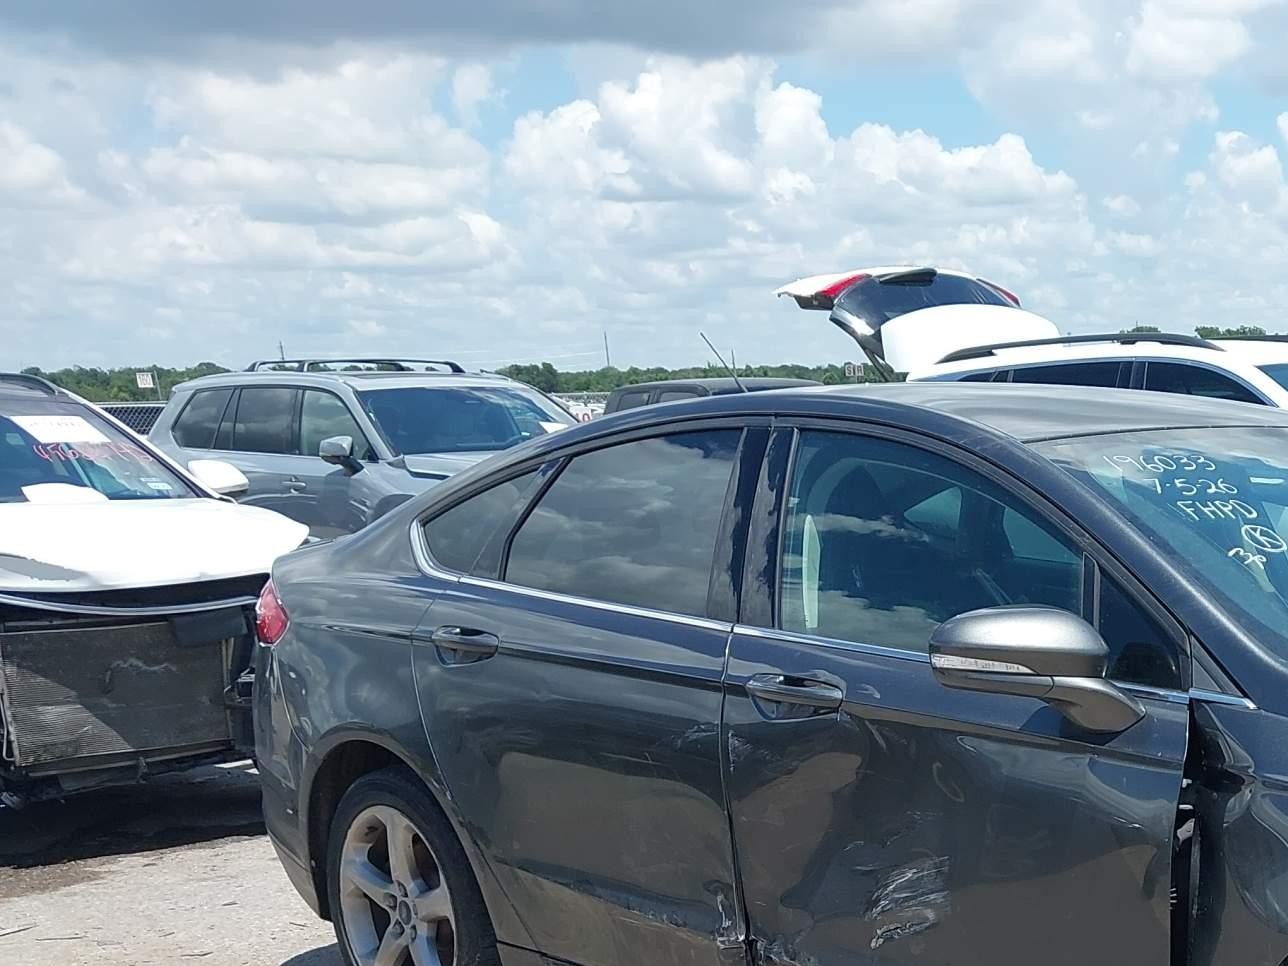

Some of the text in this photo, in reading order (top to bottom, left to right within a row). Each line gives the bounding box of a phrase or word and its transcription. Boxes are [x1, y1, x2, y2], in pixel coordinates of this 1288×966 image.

[1103, 455, 1216, 473] 196033
[1176, 499, 1258, 521] FHPD
[1245, 526, 1283, 549] K
